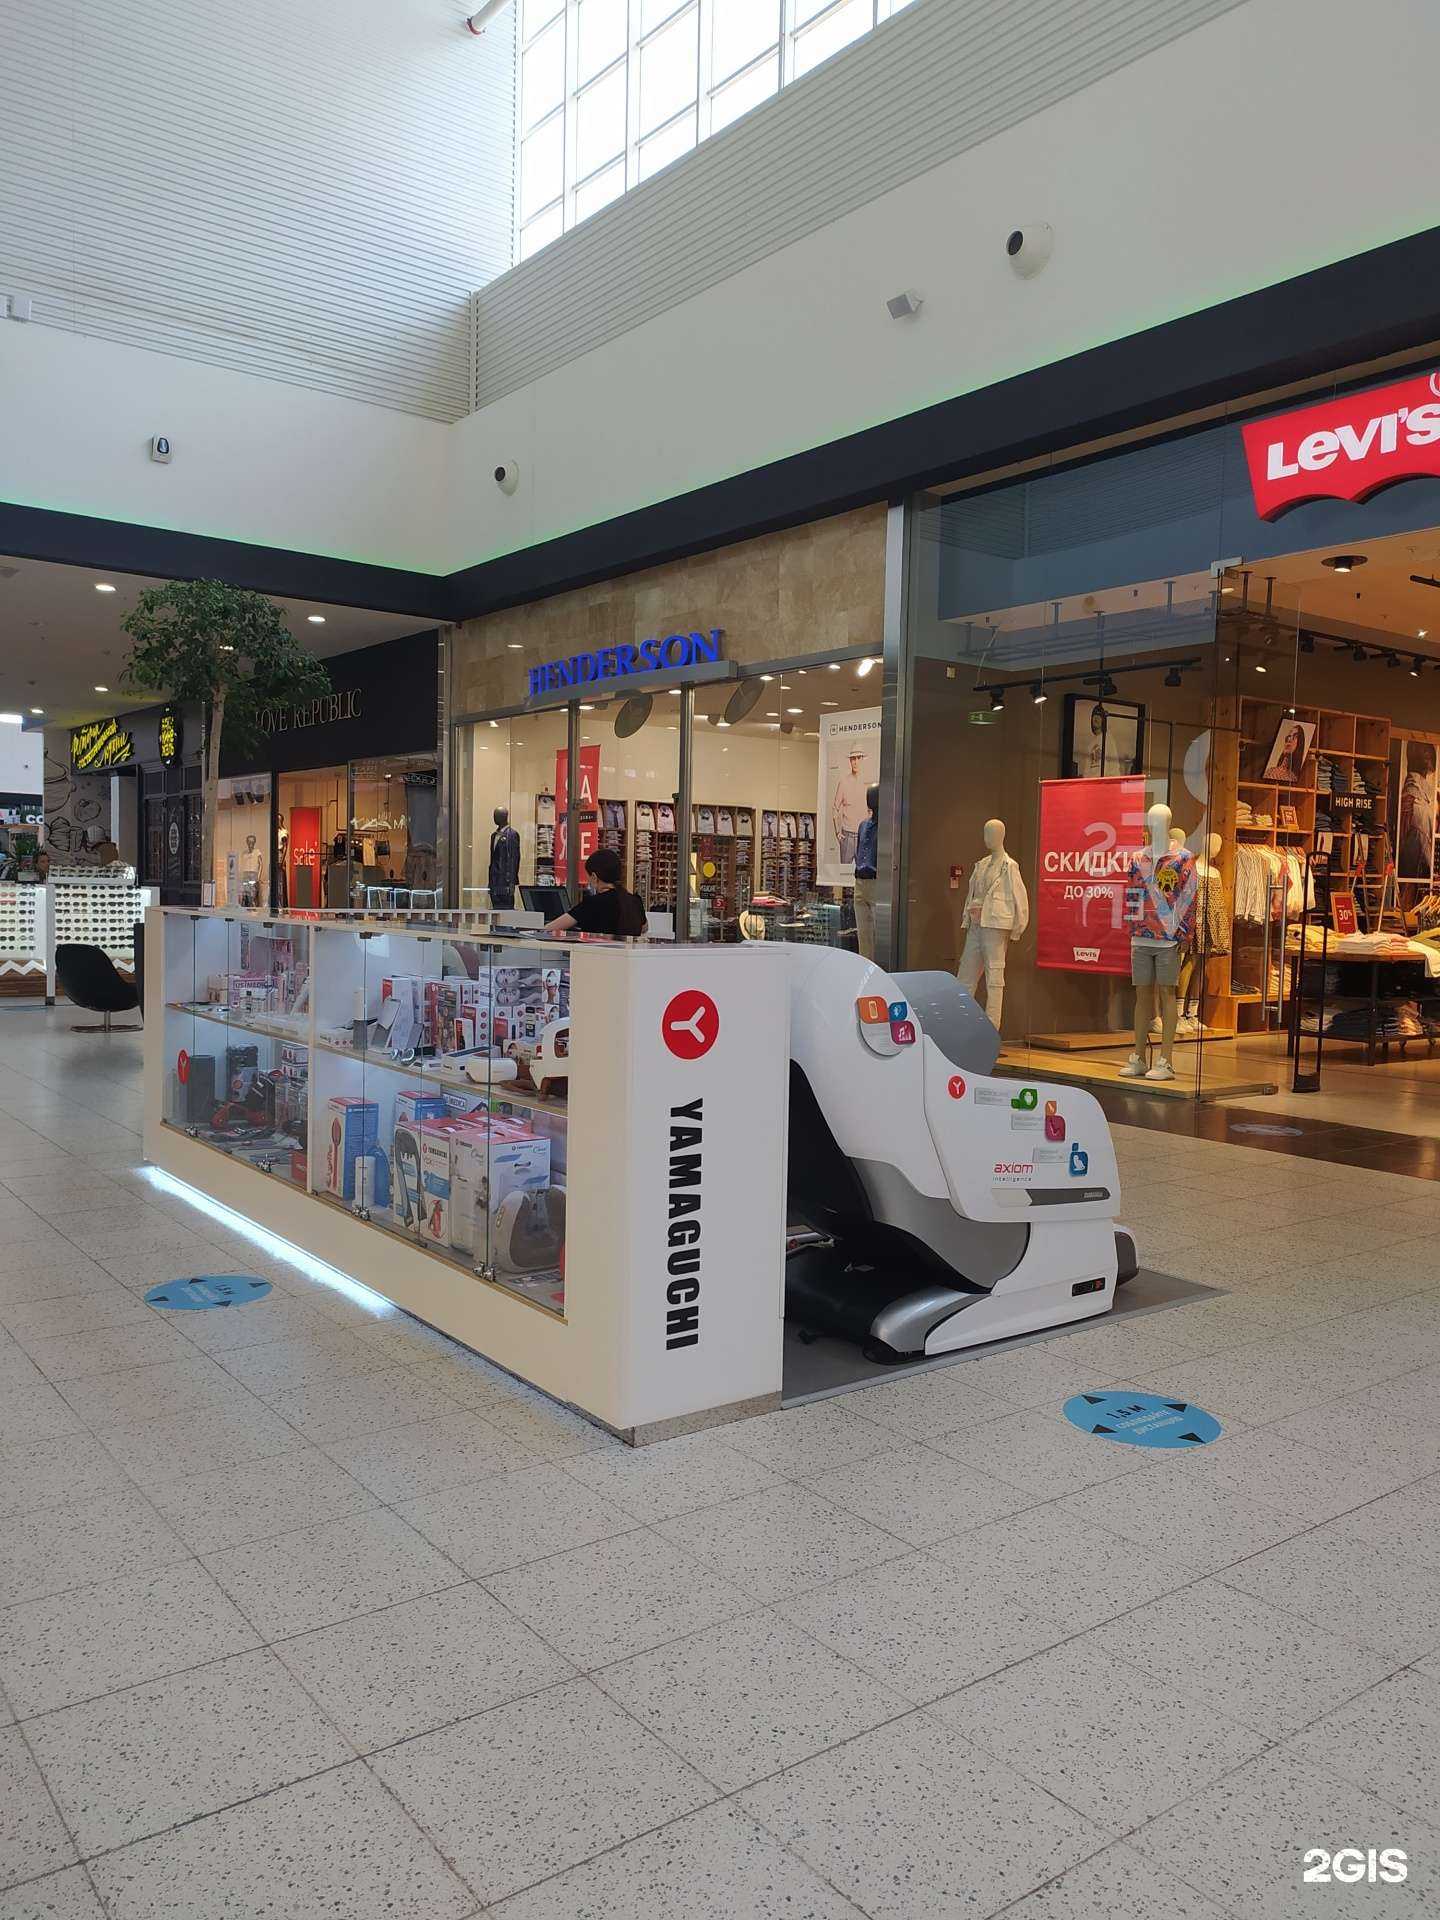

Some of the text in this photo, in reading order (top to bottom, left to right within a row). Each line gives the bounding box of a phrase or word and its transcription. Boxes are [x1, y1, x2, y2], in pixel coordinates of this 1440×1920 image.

[1267, 403, 1440, 480] Levi's
[528, 629, 722, 697] HENDERSON
[293, 688, 362, 729] REPUBLIC
[838, 721, 882, 732] HENDERSON
[1335, 797, 1373, 809] HIGH RISE
[1063, 885, 1115, 900] ДО 30%
[1338, 909, 1353, 921] 30%
[994, 1162, 1034, 1174] axiom
[665, 1097, 704, 1351] YAMAGUCHI
